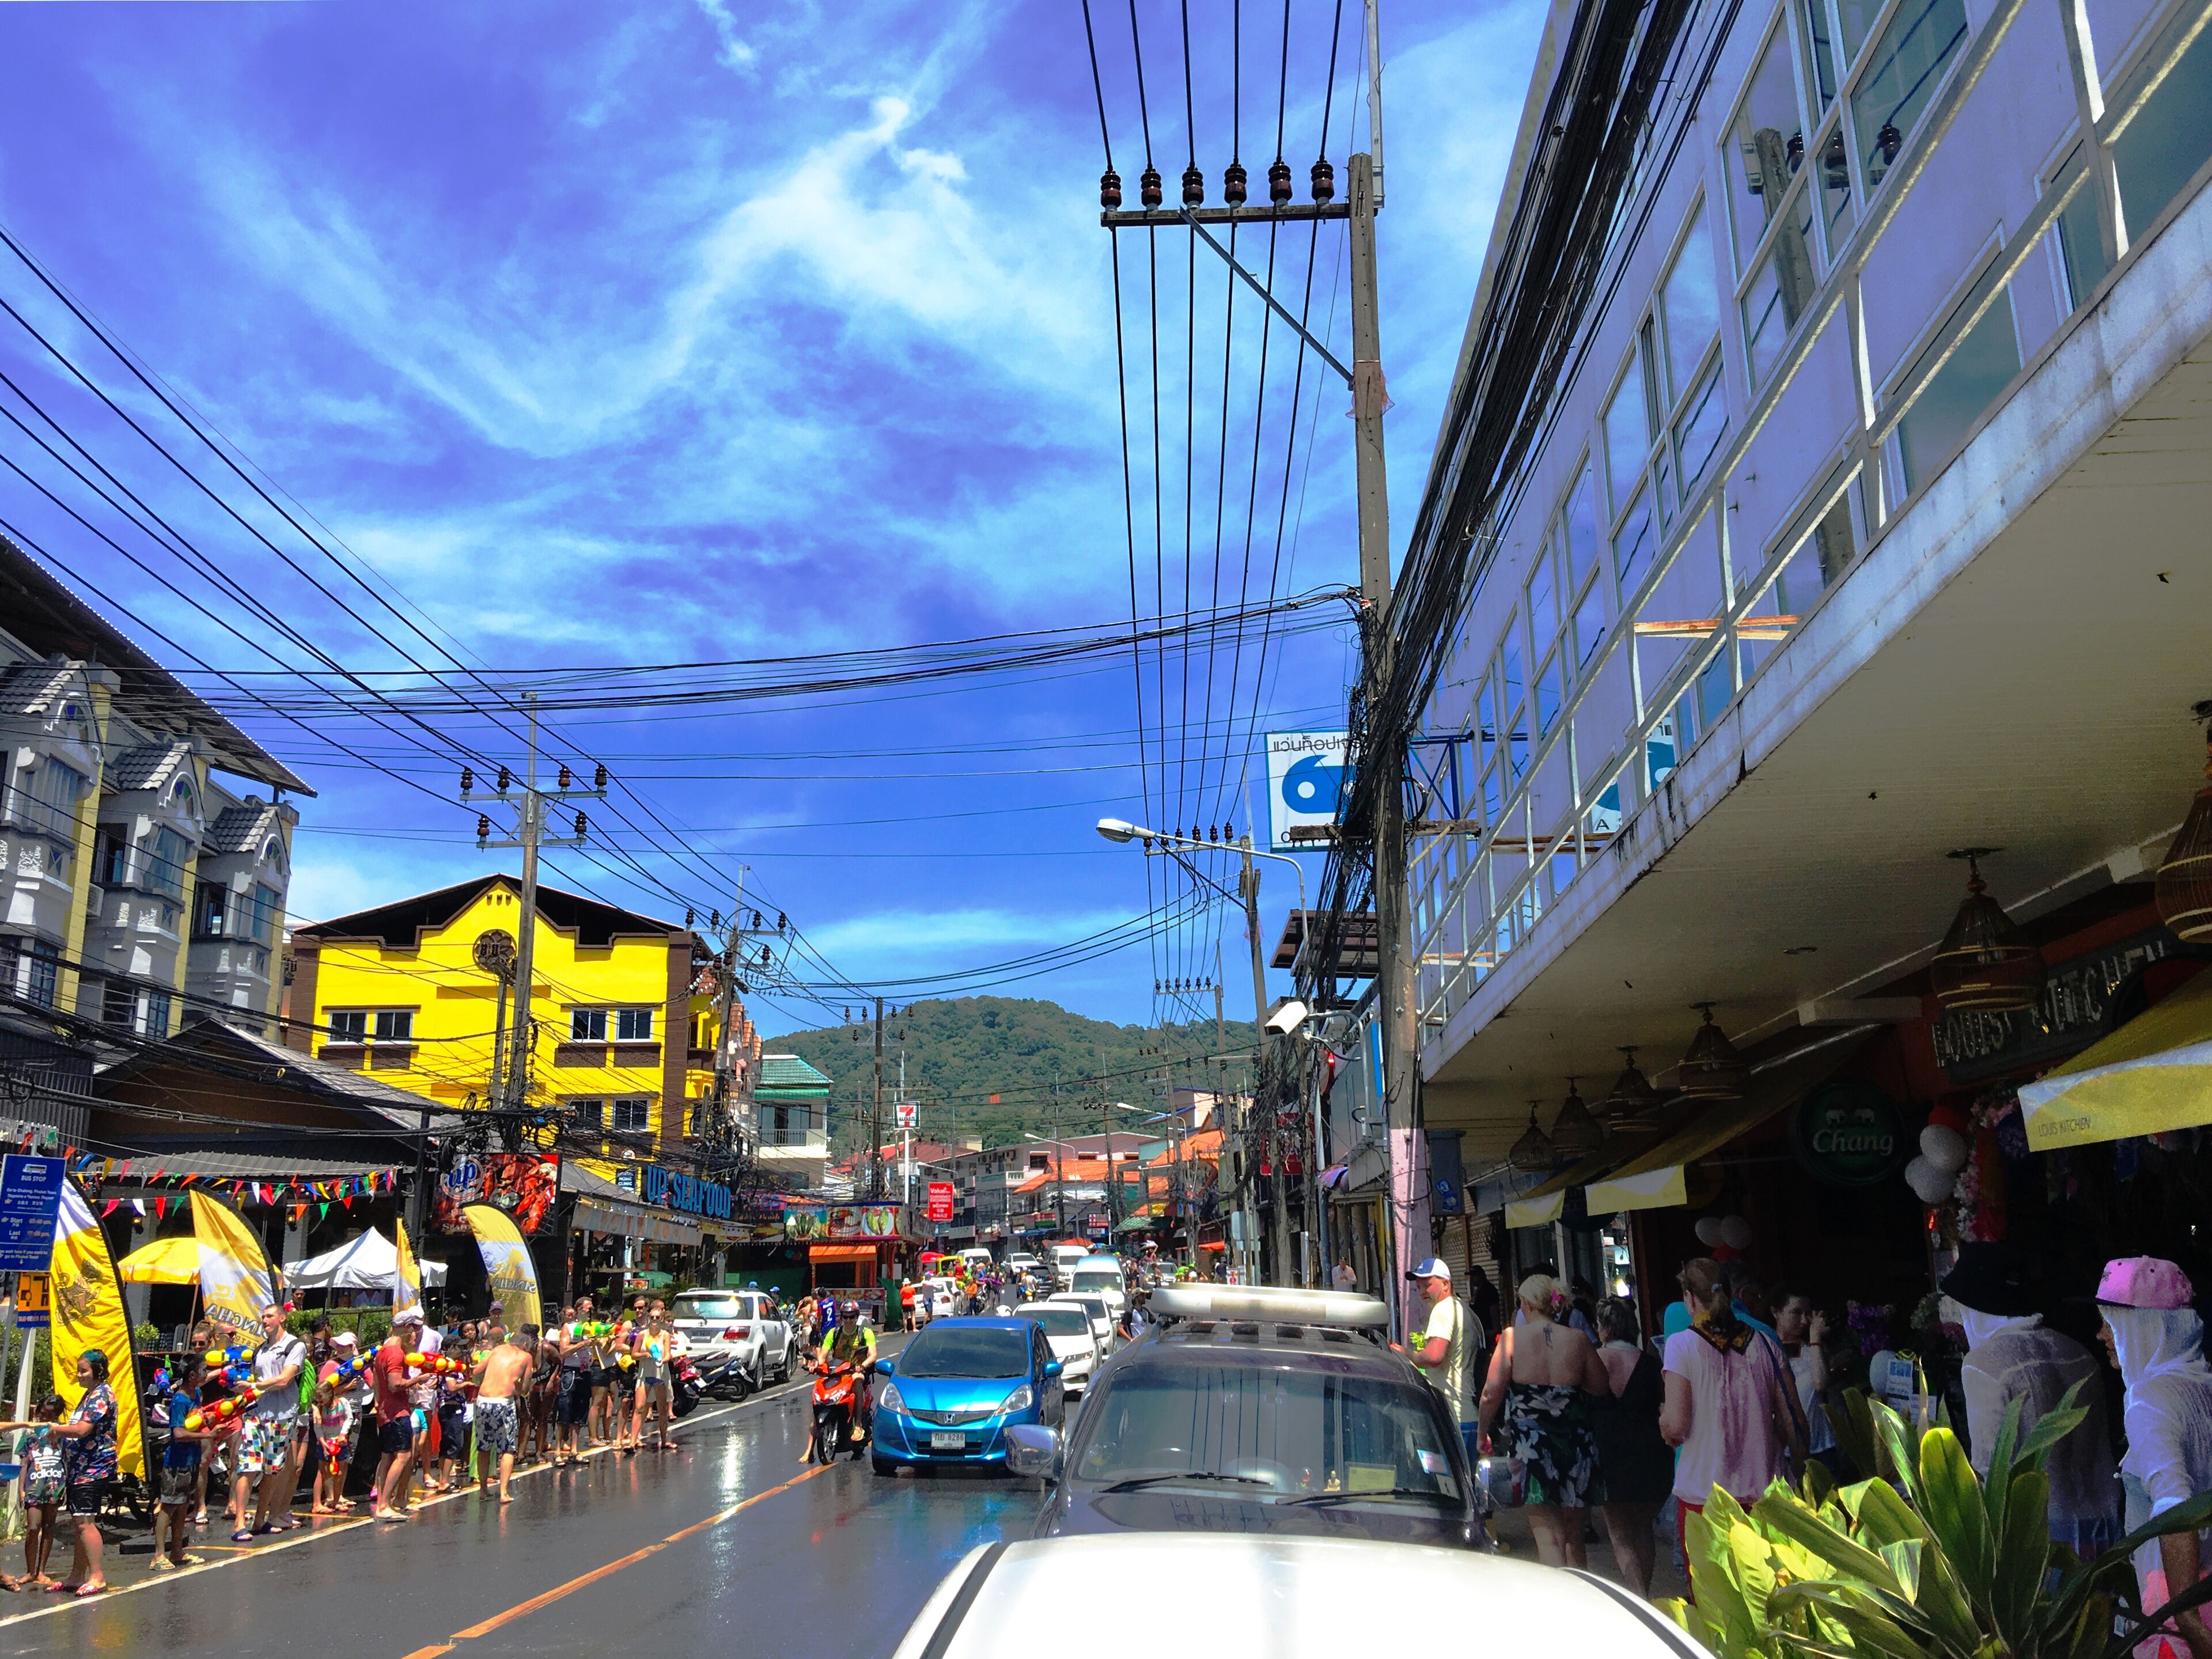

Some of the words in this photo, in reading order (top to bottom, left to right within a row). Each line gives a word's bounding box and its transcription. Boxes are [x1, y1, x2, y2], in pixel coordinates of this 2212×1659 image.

[1813, 1129, 1894, 1156] Chang
[647, 1165, 667, 1204] UP
[673, 1172, 731, 1218] SEAFOOD
[827, 1307, 832, 1321] 2
[30, 1468, 62, 1480] adidas
